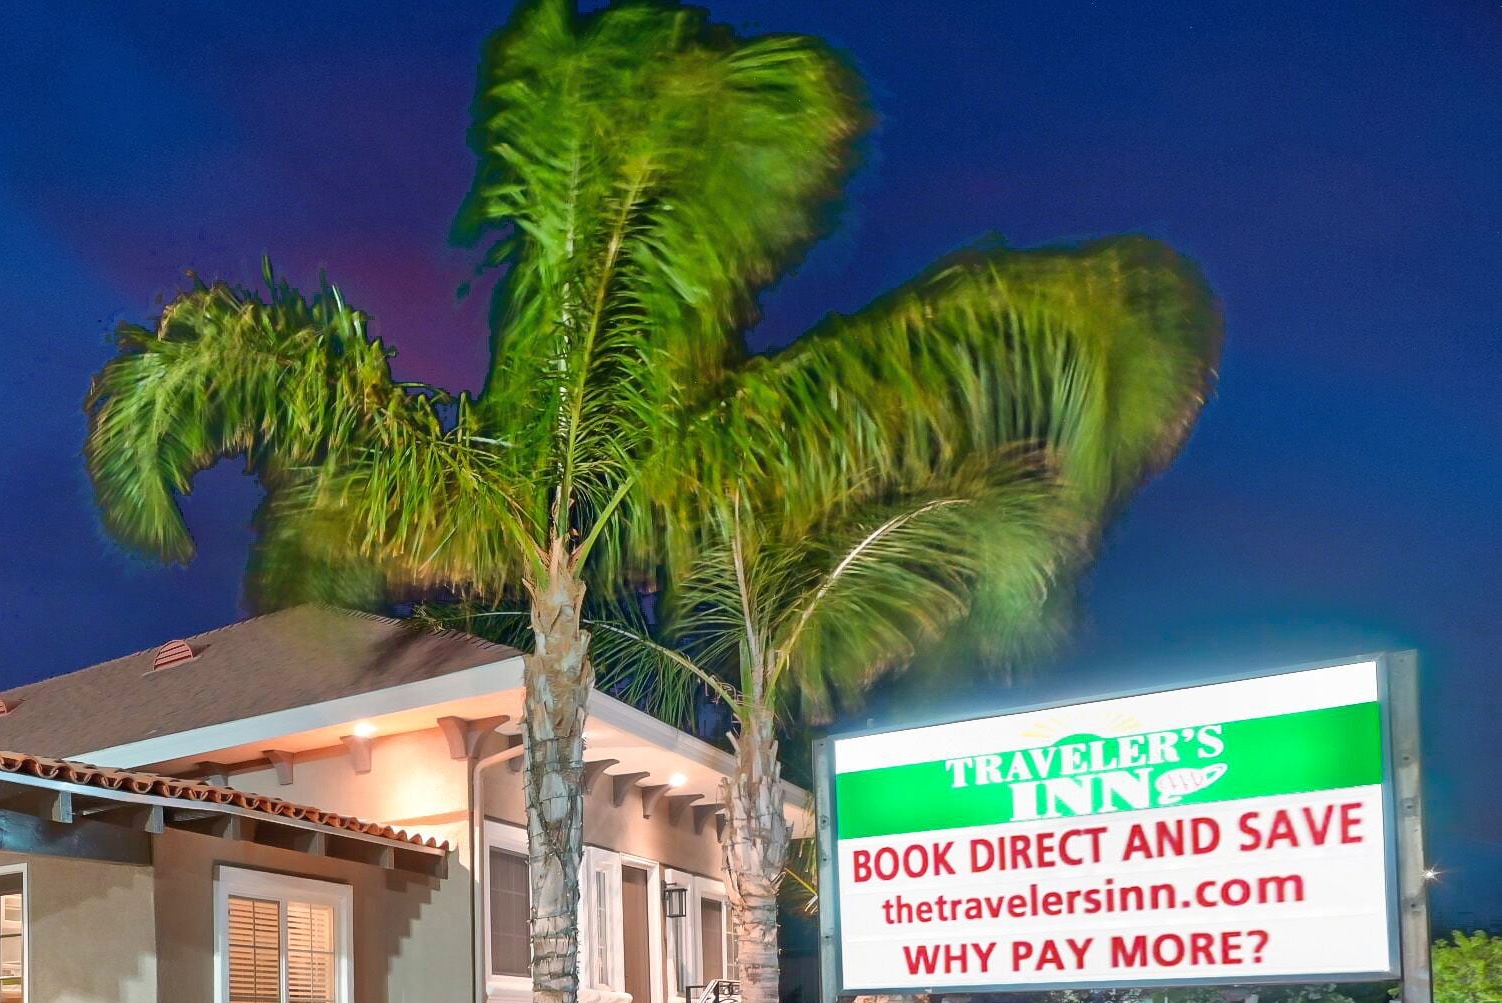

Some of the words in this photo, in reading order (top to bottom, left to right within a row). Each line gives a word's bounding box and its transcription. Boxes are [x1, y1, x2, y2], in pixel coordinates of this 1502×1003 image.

[945, 724, 1225, 788] TRAVELER'S
[1009, 767, 1154, 822] INN
[853, 841, 956, 883] BOOK
[970, 826, 1109, 874] DIRECT
[1122, 817, 1221, 861] AND
[1238, 802, 1364, 851] SAVE
[882, 874, 1305, 925] thetravelersinn.com
[903, 942, 997, 976] WHY
[1011, 937, 1094, 972] PAY
[1110, 929, 1269, 968] MORE?
